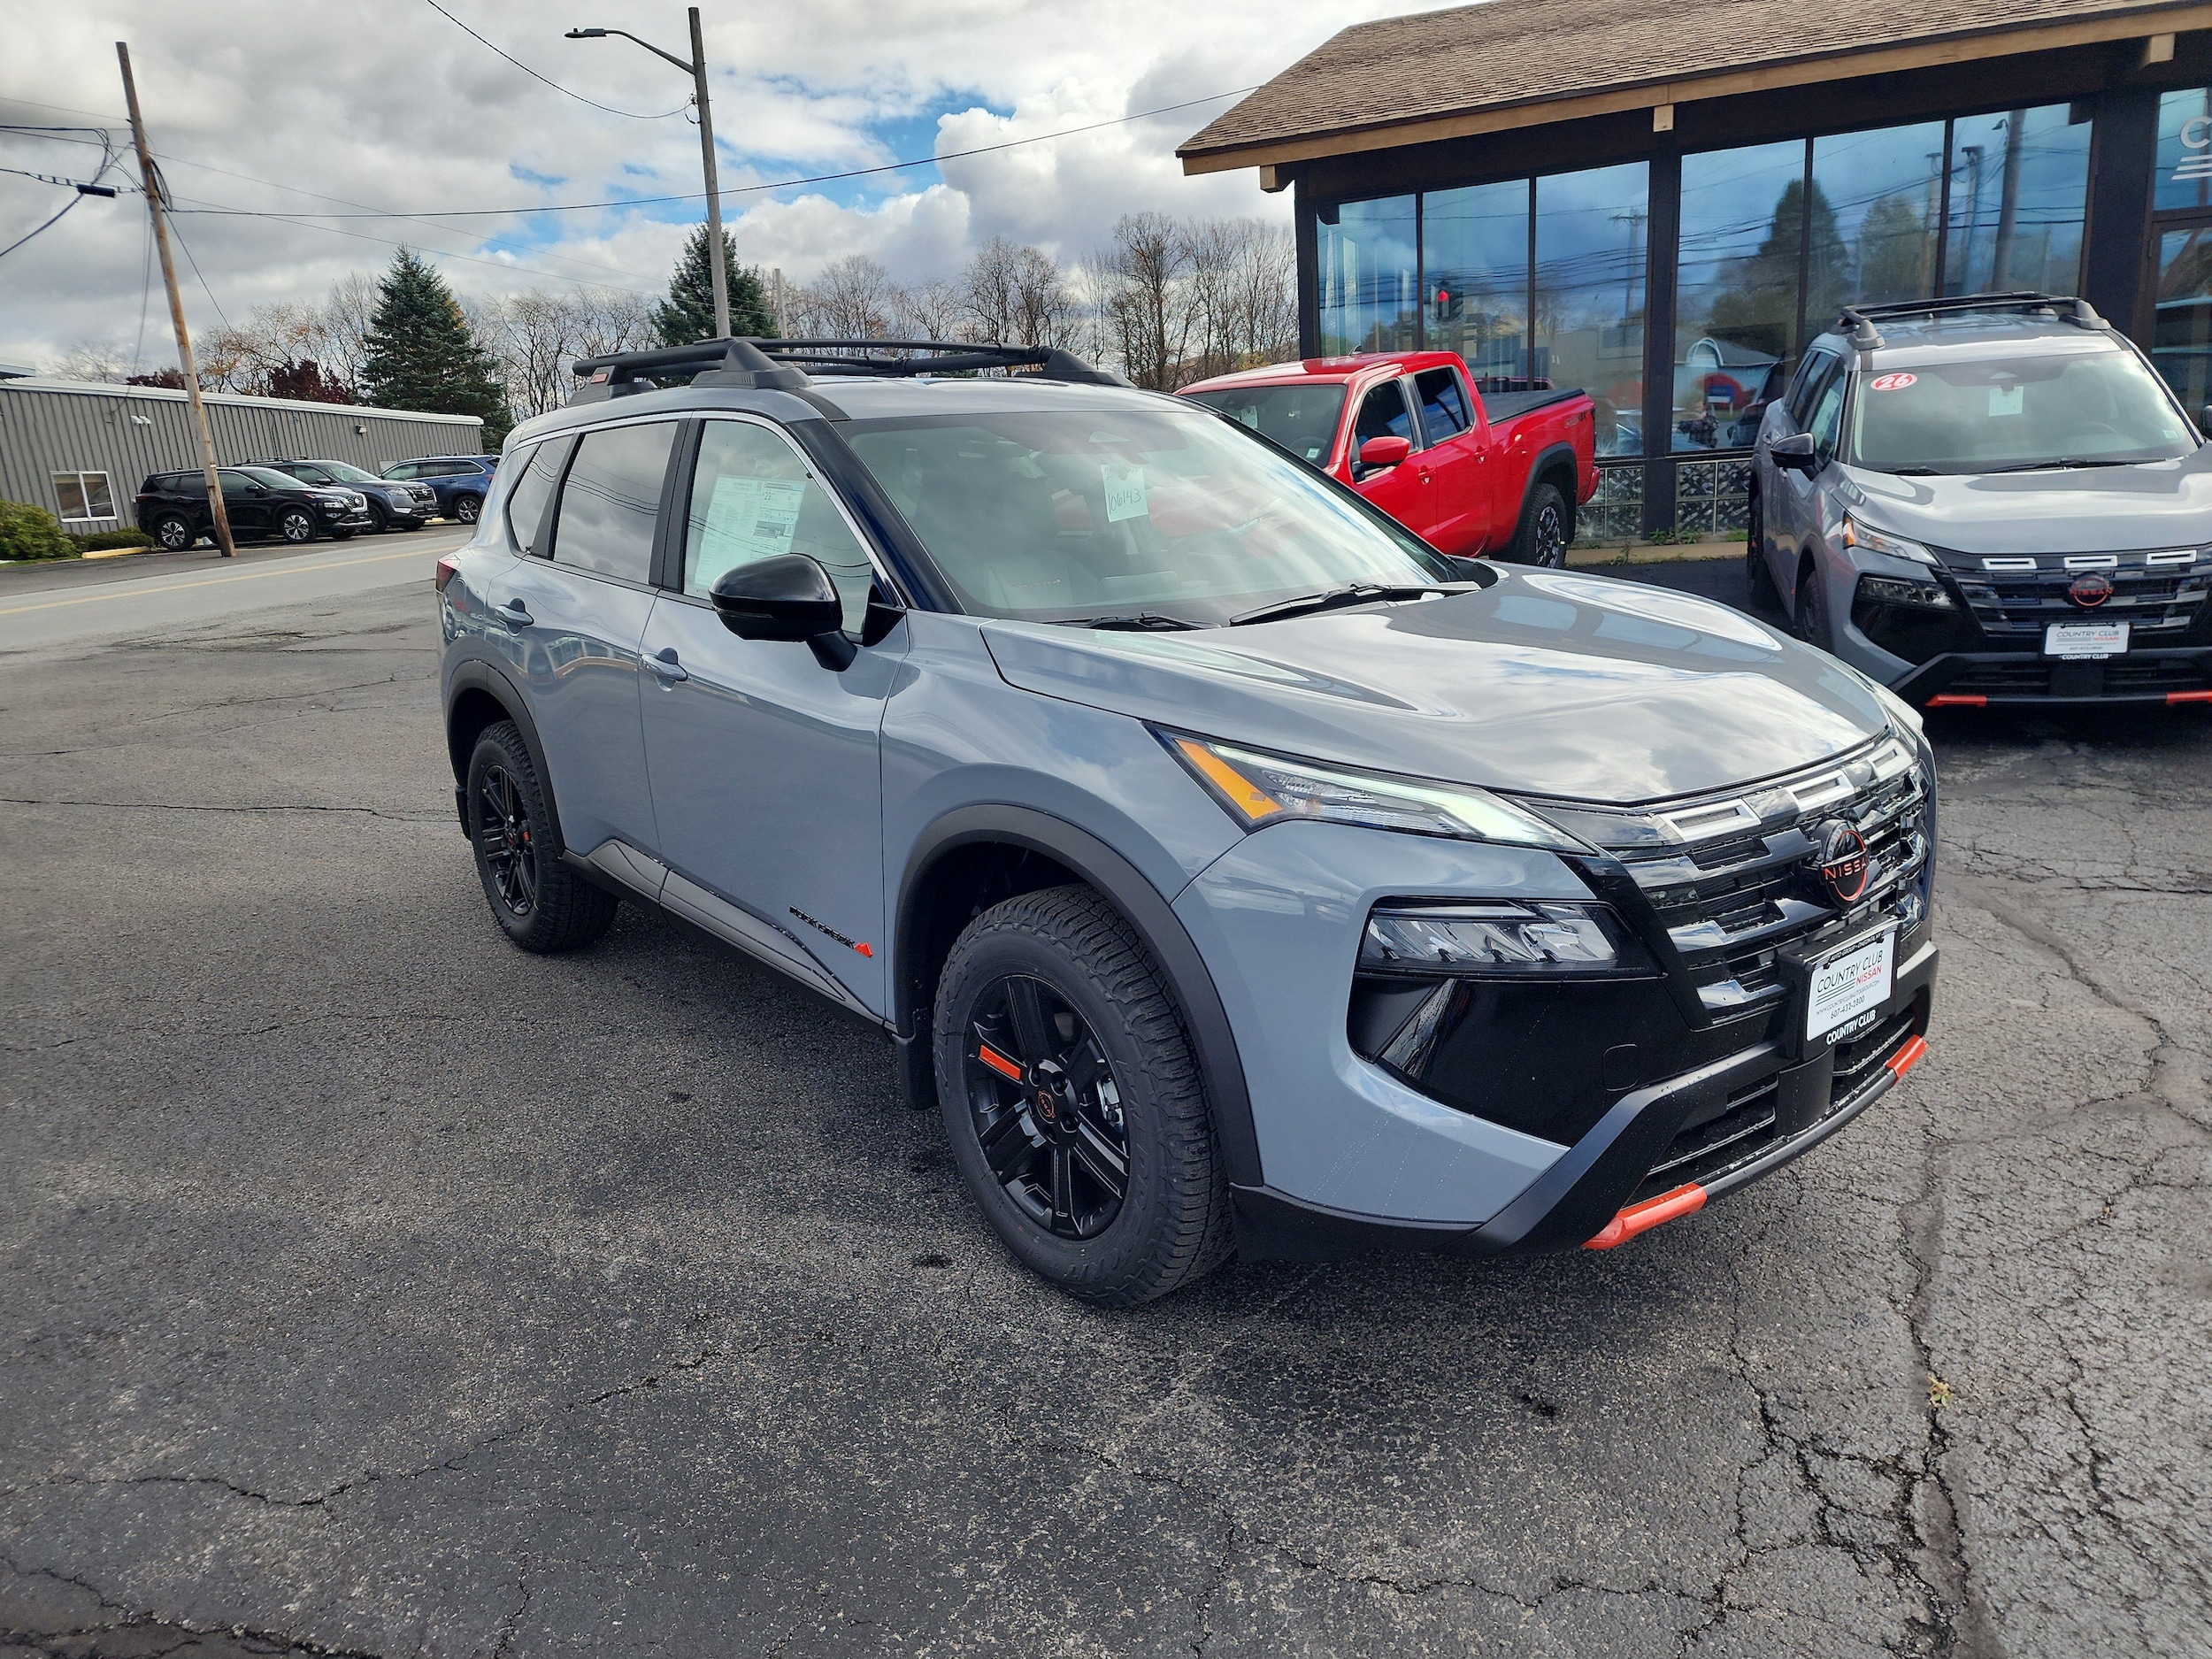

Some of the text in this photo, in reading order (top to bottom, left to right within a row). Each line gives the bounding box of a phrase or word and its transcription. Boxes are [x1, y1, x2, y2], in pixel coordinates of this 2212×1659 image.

[1877, 373, 1910, 390] 26
[1109, 488, 1141, 515] 106143
[1816, 949, 1884, 994] COUNTRY CLUB
[1855, 964, 1882, 986] NISSAN
[1830, 995, 1865, 1019] 607-432-2800
[1826, 1009, 1877, 1046] COUNTRY CLUB
